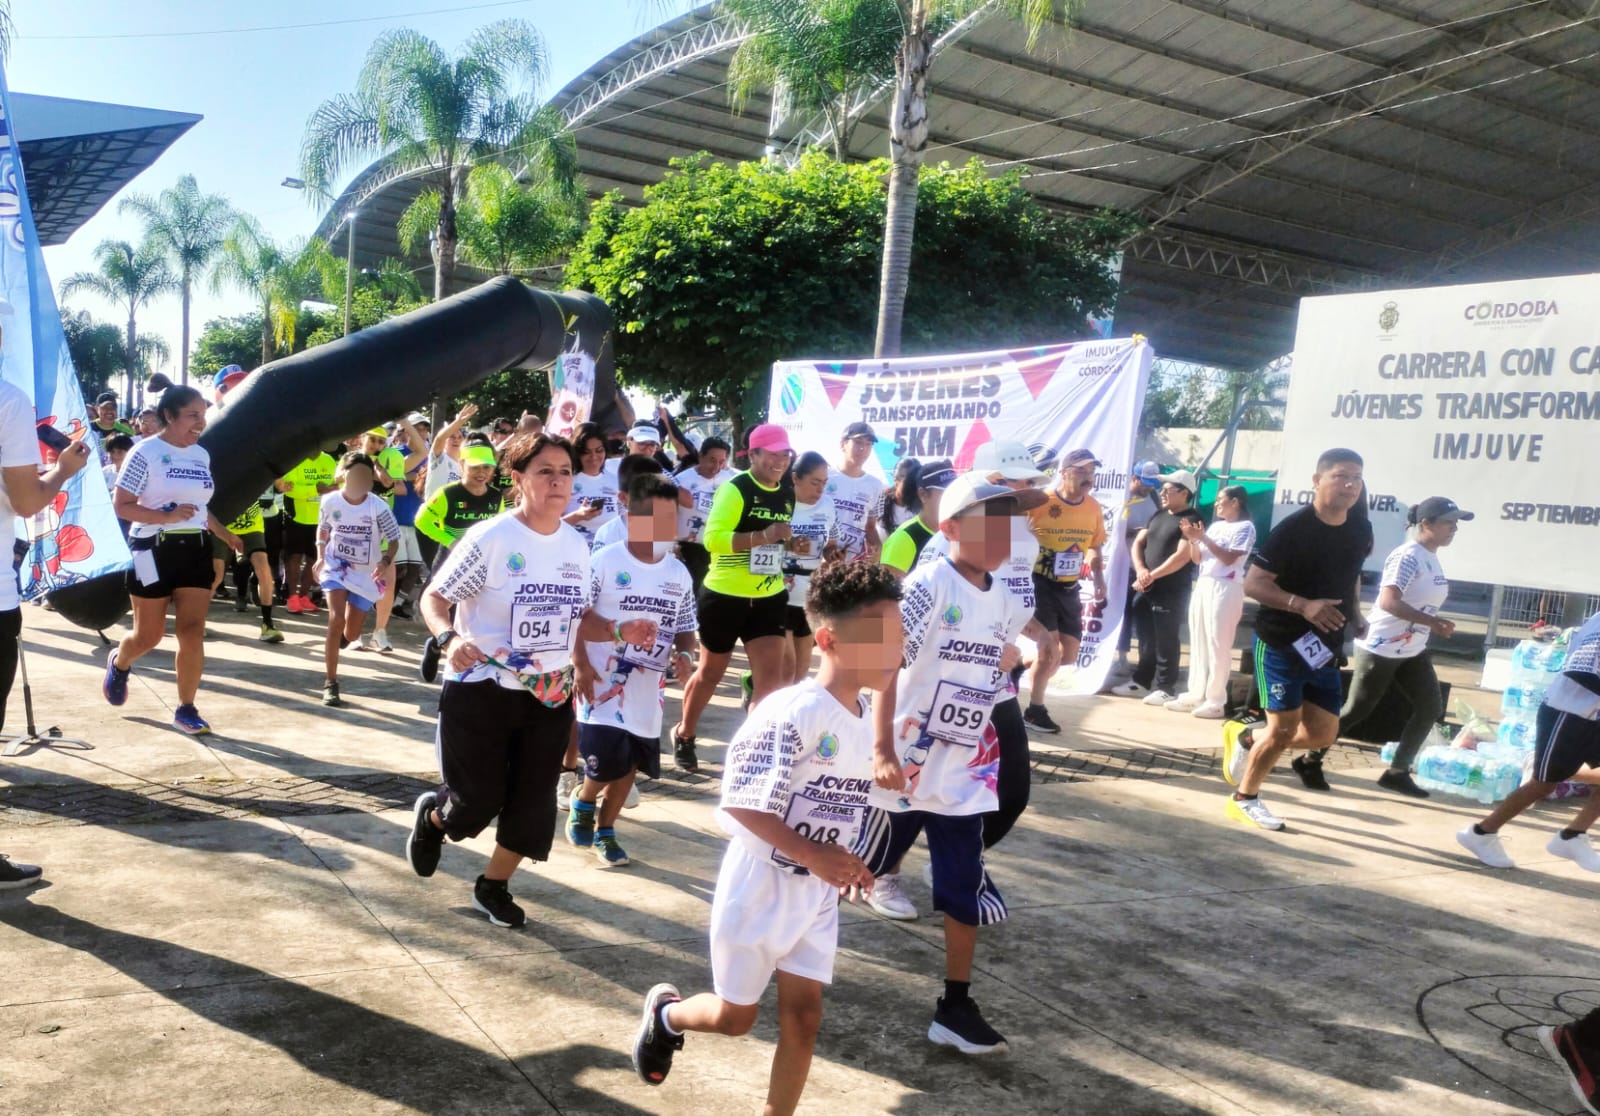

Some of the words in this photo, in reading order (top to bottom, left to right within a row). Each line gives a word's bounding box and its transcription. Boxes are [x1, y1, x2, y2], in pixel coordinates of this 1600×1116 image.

[1378, 350, 1487, 379] CARRERA
[1500, 347, 1556, 377] CON
[860, 361, 1002, 405] JÓVENES
[861, 401, 1002, 423] TRANSFORMANDO
[1331, 389, 1424, 420] JÓVENES
[893, 425, 957, 457] 5KM
[1432, 432, 1544, 462] IMJUVE
[833, 498, 865, 510] OVENES
[1369, 494, 1400, 513] VER.
[338, 543, 356, 557] 061
[754, 553, 774, 566] 221
[514, 583, 582, 596] JOVENES
[619, 595, 677, 609] JOVENES
[518, 620, 550, 639] 054
[660, 615, 675, 628] 5K
[1304, 640, 1322, 658] 27
[940, 703, 984, 730] 059
[814, 804, 855, 816] JOVENES
[794, 821, 840, 845] 048
